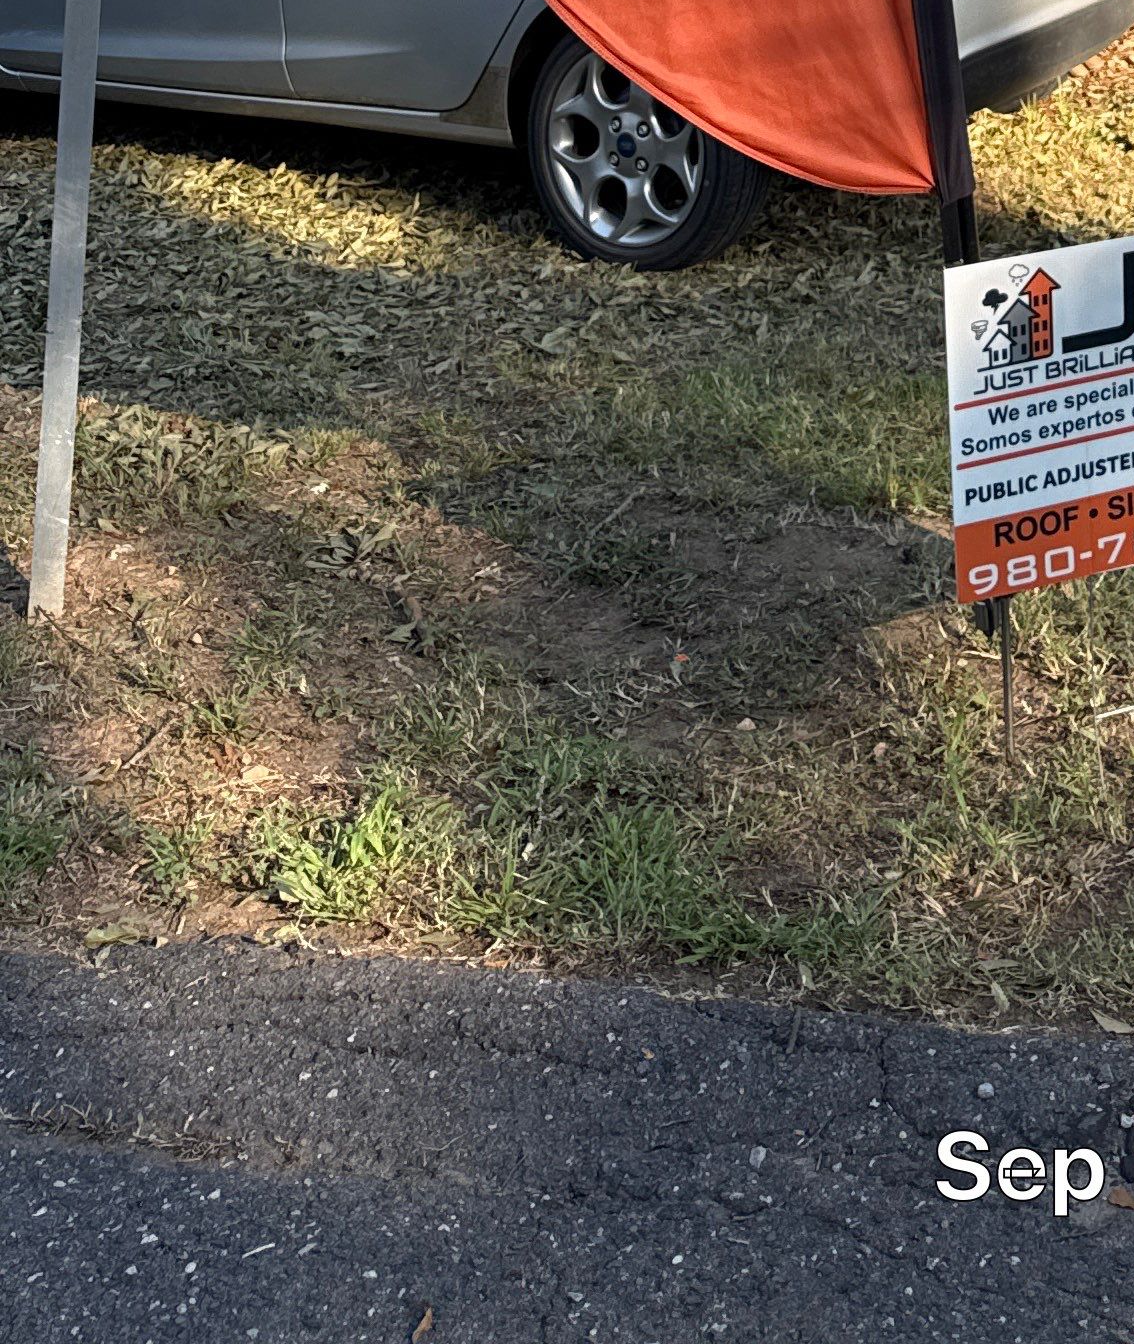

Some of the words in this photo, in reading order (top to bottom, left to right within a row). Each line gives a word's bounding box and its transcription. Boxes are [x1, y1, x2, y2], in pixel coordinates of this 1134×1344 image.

[974, 365, 1038, 395] JUST
[988, 405, 1020, 425] We
[1027, 399, 1057, 416] are
[961, 429, 1032, 456] Somos
[1039, 408, 1125, 438] expertos
[965, 475, 1039, 506] PUBLIC
[994, 506, 1079, 547] ROOF
